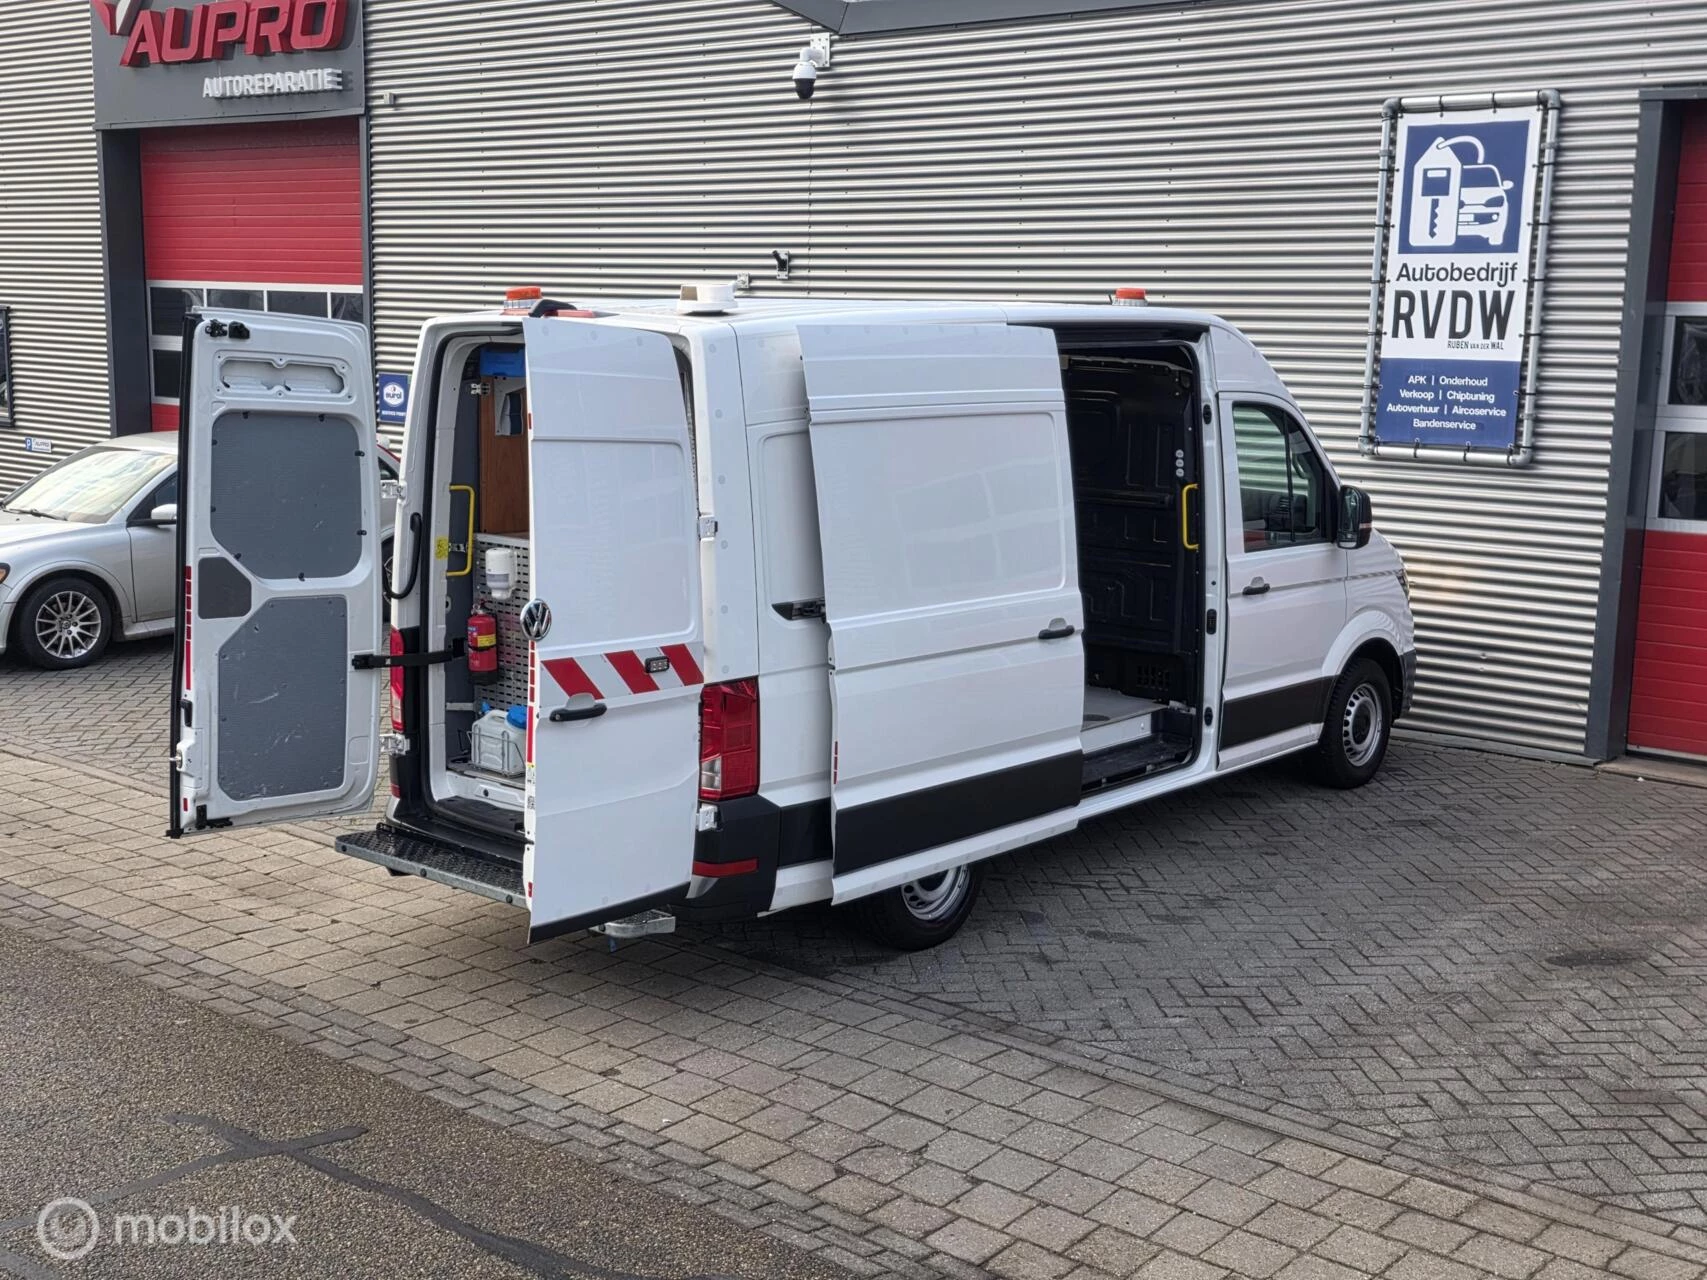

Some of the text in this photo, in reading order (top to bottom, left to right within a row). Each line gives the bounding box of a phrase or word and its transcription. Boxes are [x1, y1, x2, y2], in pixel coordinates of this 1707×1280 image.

[120, 0, 345, 66] AUPRO
[202, 68, 343, 99] AUTOREPARATIE
[1395, 262, 1518, 288] Autobedrijf
[1391, 289, 1516, 341] RVDW
[1447, 340, 1469, 349] RUBEN
[1407, 375, 1427, 385] APK
[1439, 376, 1488, 387] Onderhoud
[1399, 389, 1435, 401] Verkoop
[1446, 390, 1495, 404] Chiptuning
[1386, 403, 1440, 414] Autoverhuur
[1452, 405, 1507, 417] Aircoservice
[1413, 419, 1477, 430] Bandenservice
